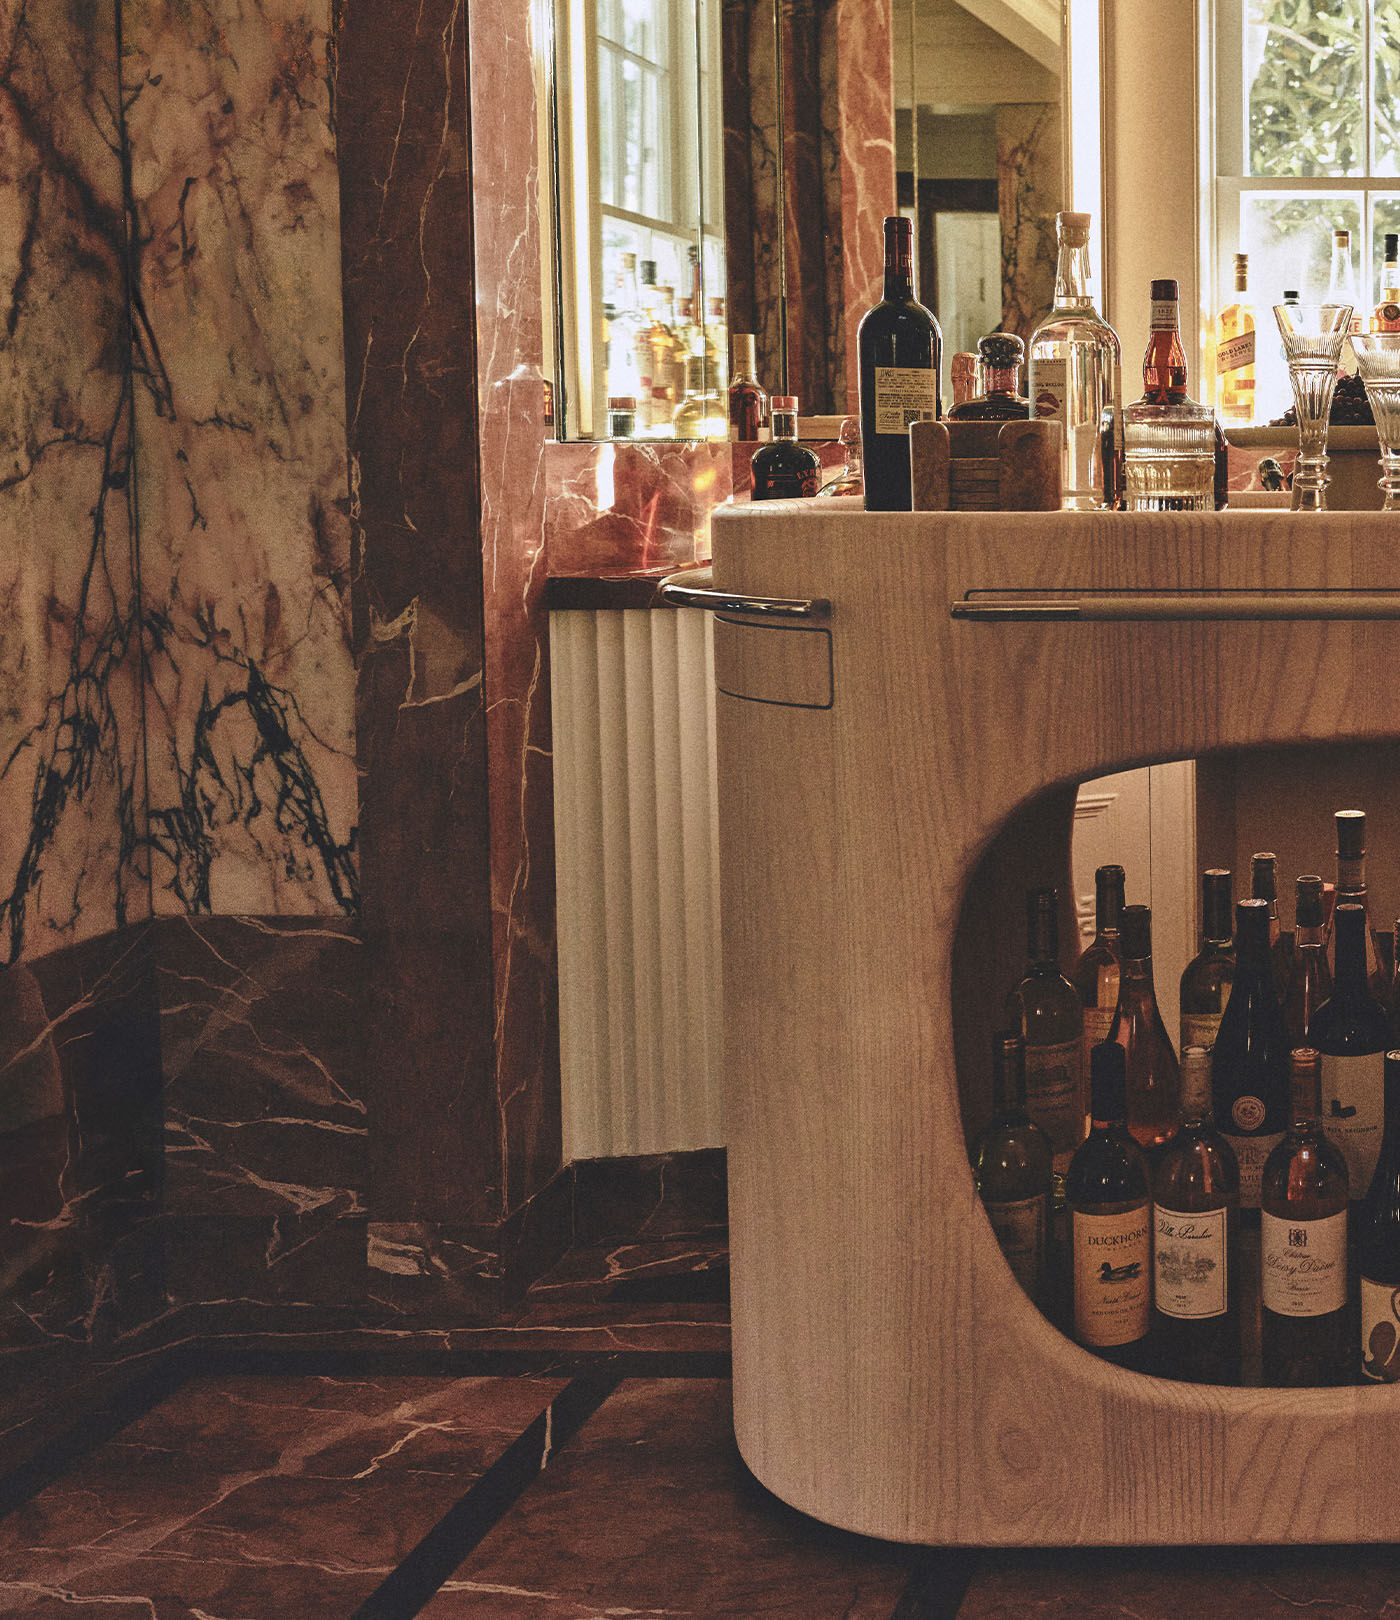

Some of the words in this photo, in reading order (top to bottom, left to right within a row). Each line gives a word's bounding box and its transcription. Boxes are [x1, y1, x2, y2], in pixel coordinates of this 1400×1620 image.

[1218, 348, 1234, 358] GOLD
[1234, 342, 1252, 353] LABEL
[796, 469, 817, 480] LYR
[1088, 1225, 1148, 1246] DUCKHORN
